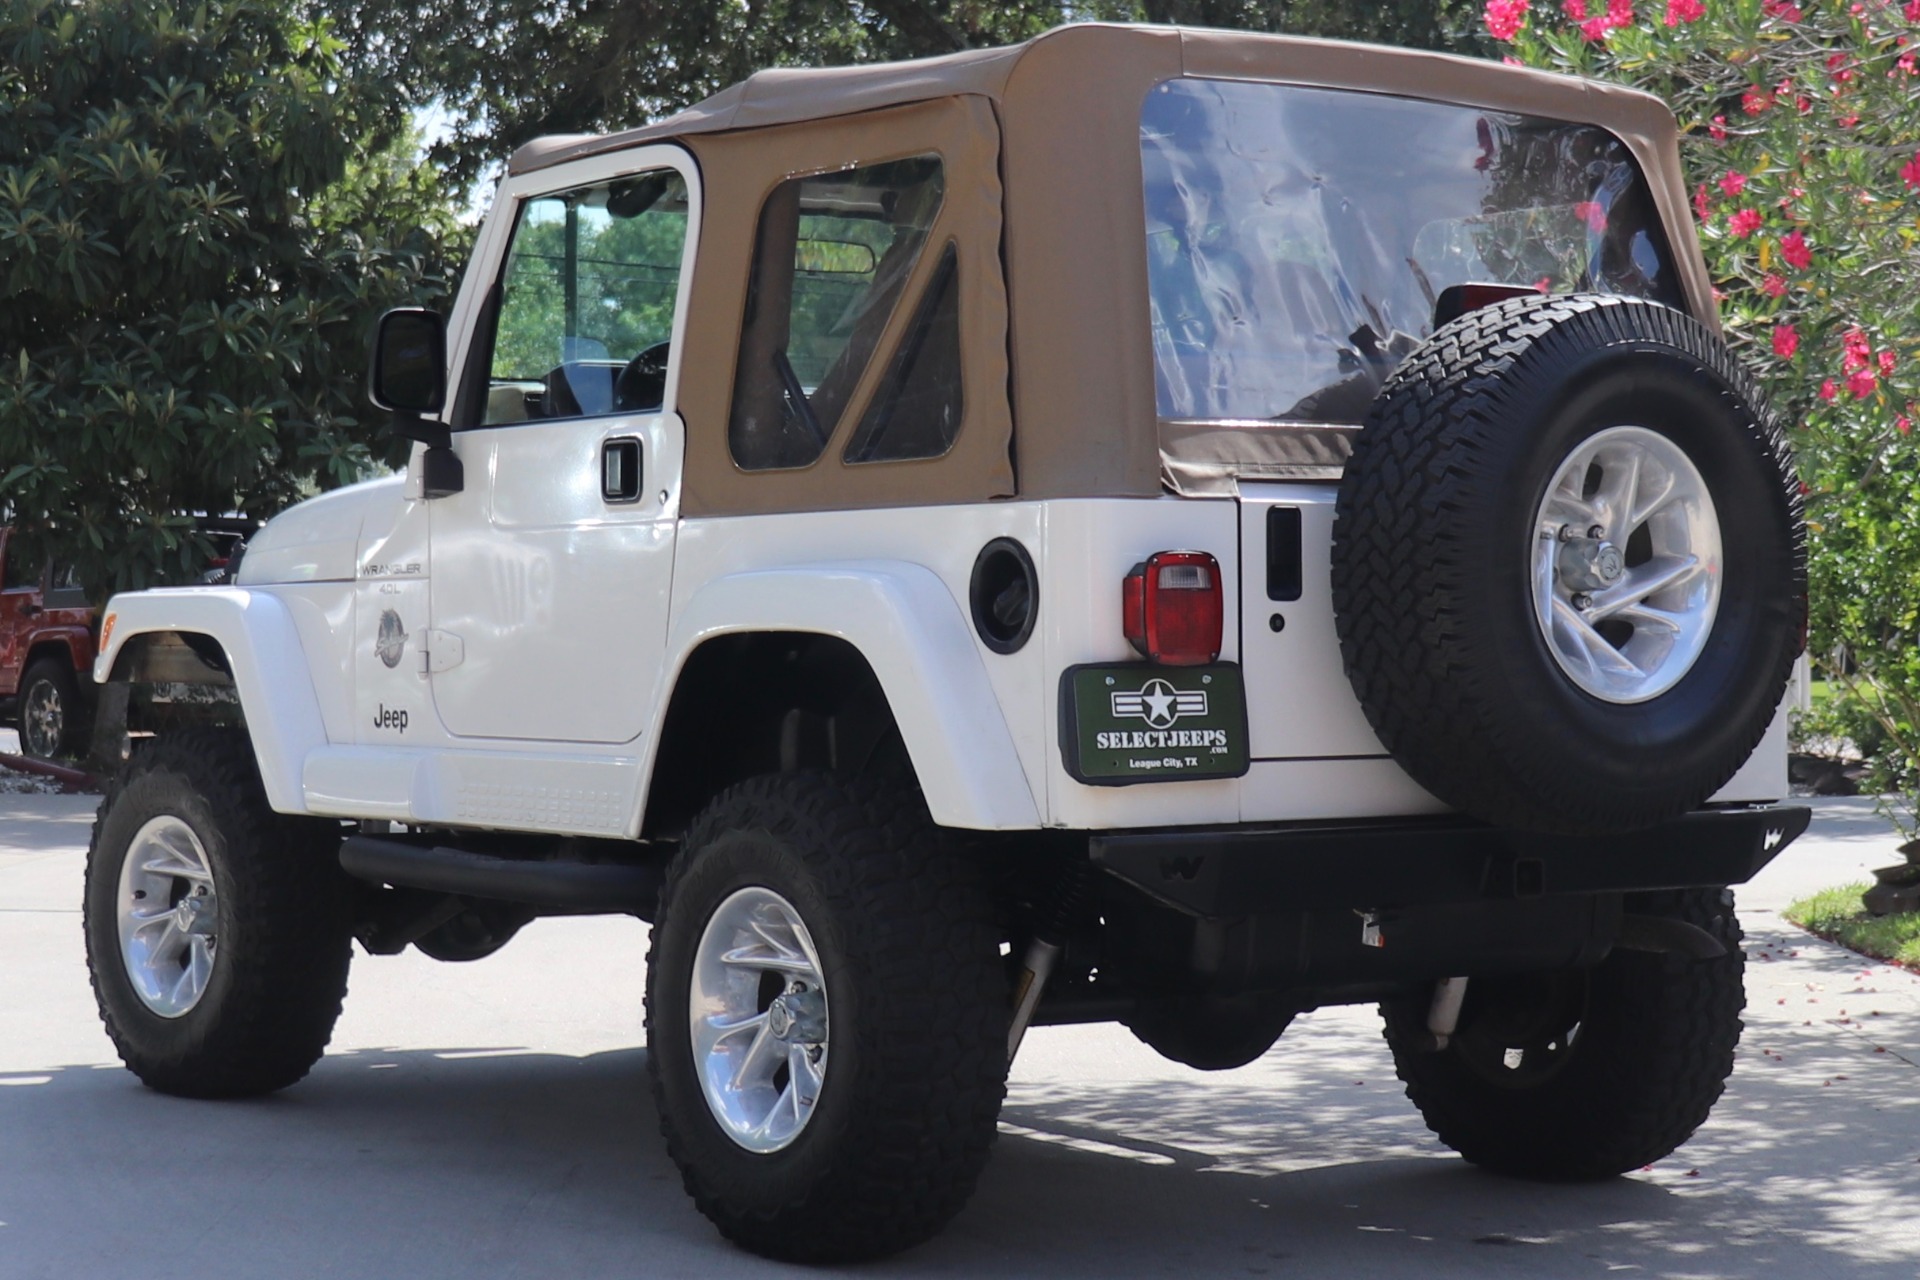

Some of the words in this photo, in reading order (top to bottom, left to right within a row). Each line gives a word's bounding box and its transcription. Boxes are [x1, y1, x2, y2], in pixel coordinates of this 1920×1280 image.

[362, 563, 421, 575] WRANGLER
[374, 703, 408, 734] Jeep
[1096, 730, 1227, 749] SELECTJEEPS
[1129, 758, 1161, 769] League
[1162, 757, 1183, 769] City,
[1184, 757, 1198, 767] TX
